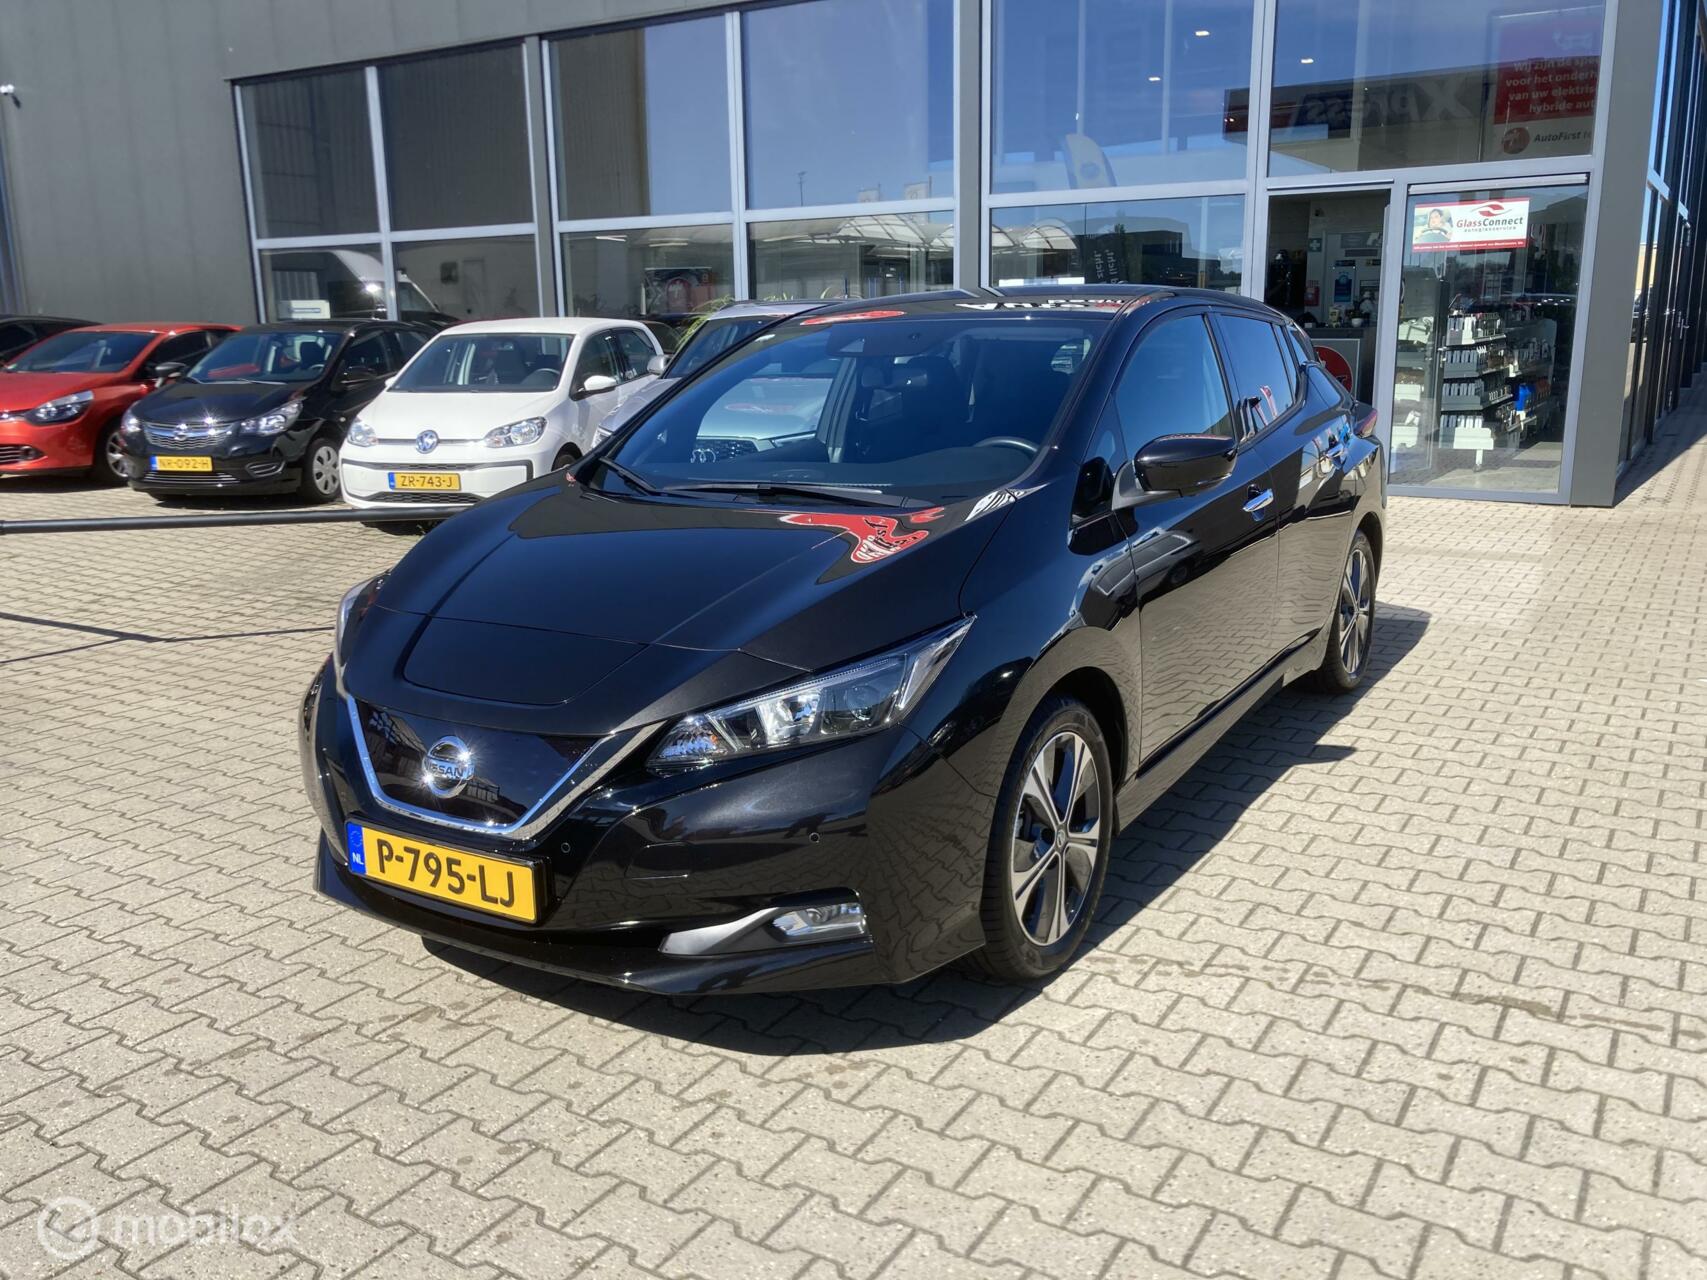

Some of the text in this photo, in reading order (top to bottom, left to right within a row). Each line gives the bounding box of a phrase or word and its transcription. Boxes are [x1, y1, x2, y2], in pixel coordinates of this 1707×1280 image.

[1505, 78, 1531, 87] voor
[1534, 74, 1553, 84] het
[1508, 92, 1529, 101] van
[1531, 89, 1549, 99] uw
[1529, 100, 1574, 114] hybride
[1534, 132, 1581, 142] AutoFirst
[1456, 216, 1524, 228] GlassConnect
[400, 475, 453, 488] ZR-743-J
[352, 852, 365, 865] NL
[376, 838, 515, 908] P-795-LJ
